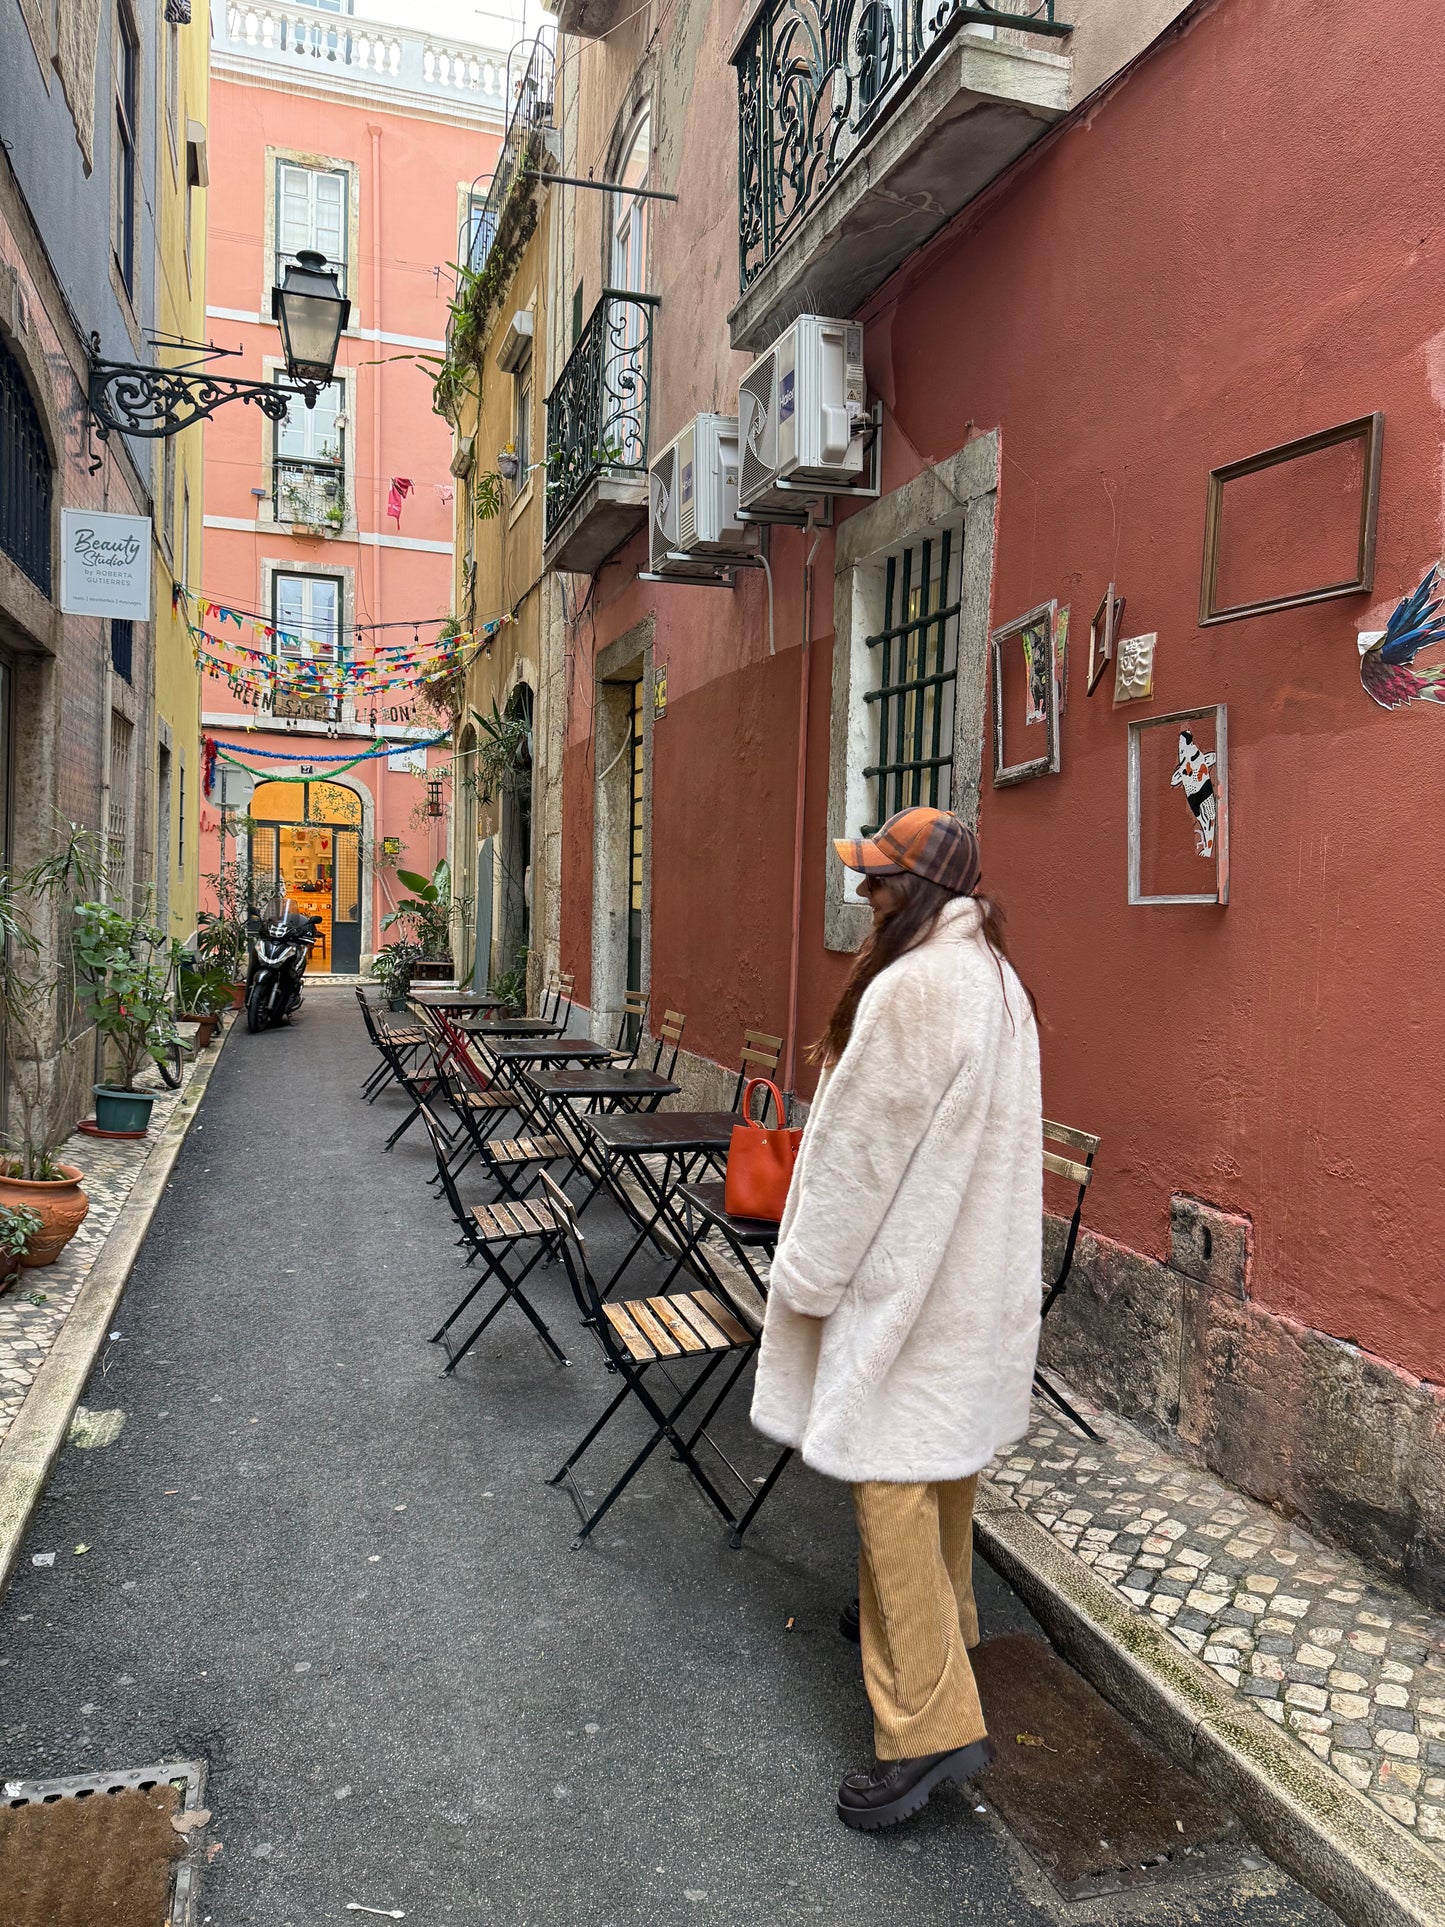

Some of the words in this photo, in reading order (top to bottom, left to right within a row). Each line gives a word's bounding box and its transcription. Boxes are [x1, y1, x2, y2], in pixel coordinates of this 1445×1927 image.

[74, 528, 141, 565] Beauty
[82, 550, 124, 567] Studio
[84, 568, 93, 576] by
[96, 570, 133, 579] ROBERTA
[86, 577, 131, 586] GUTIERRES
